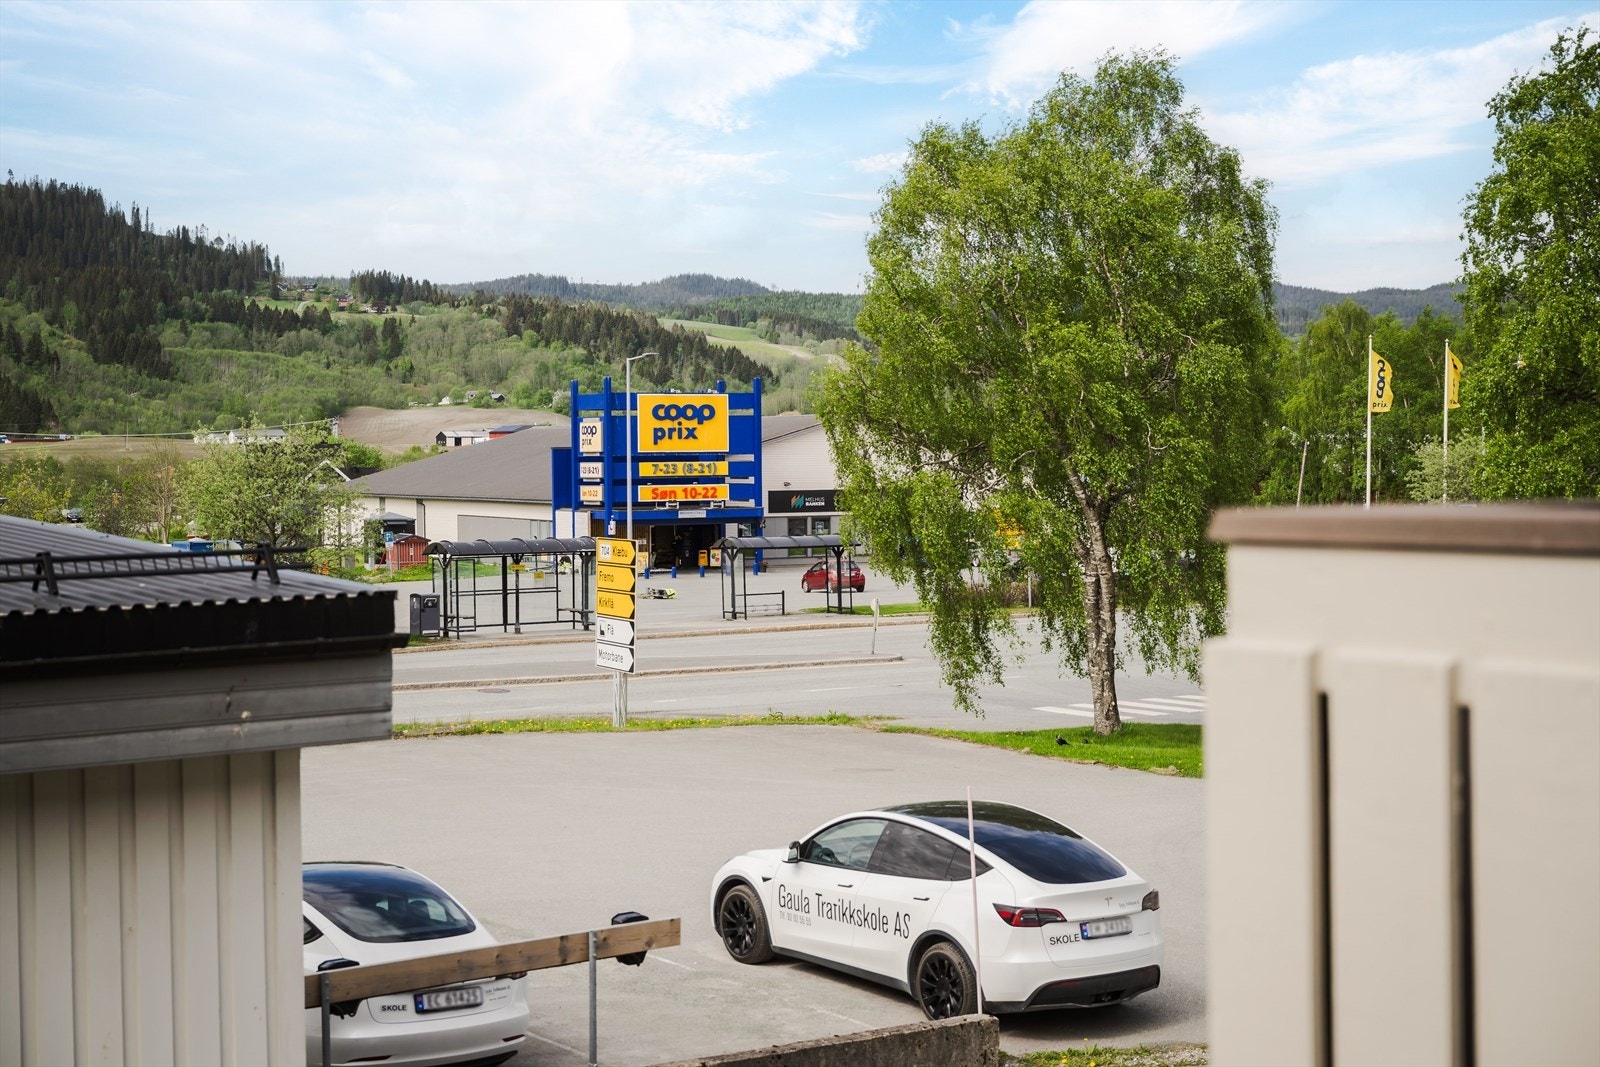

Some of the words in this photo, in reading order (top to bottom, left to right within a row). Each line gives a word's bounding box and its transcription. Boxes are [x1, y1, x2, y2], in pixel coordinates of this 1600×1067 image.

[1372, 401, 1388, 409] prix
[652, 404, 716, 425] coop
[653, 421, 698, 445] prix
[652, 463, 678, 475] 7-23
[682, 462, 717, 476] (8-21)
[651, 487, 677, 499] Søn
[682, 487, 718, 499] 10-22
[612, 545, 628, 558] Klæbu
[599, 570, 614, 583] Fremo
[599, 648, 624, 663] Motorbane
[778, 884, 811, 914] Gaula
[815, 892, 889, 933] Trafikkskole
[893, 911, 911, 939] AS
[1049, 933, 1080, 946] SKOLE
[381, 1004, 407, 1012] SKOLE
